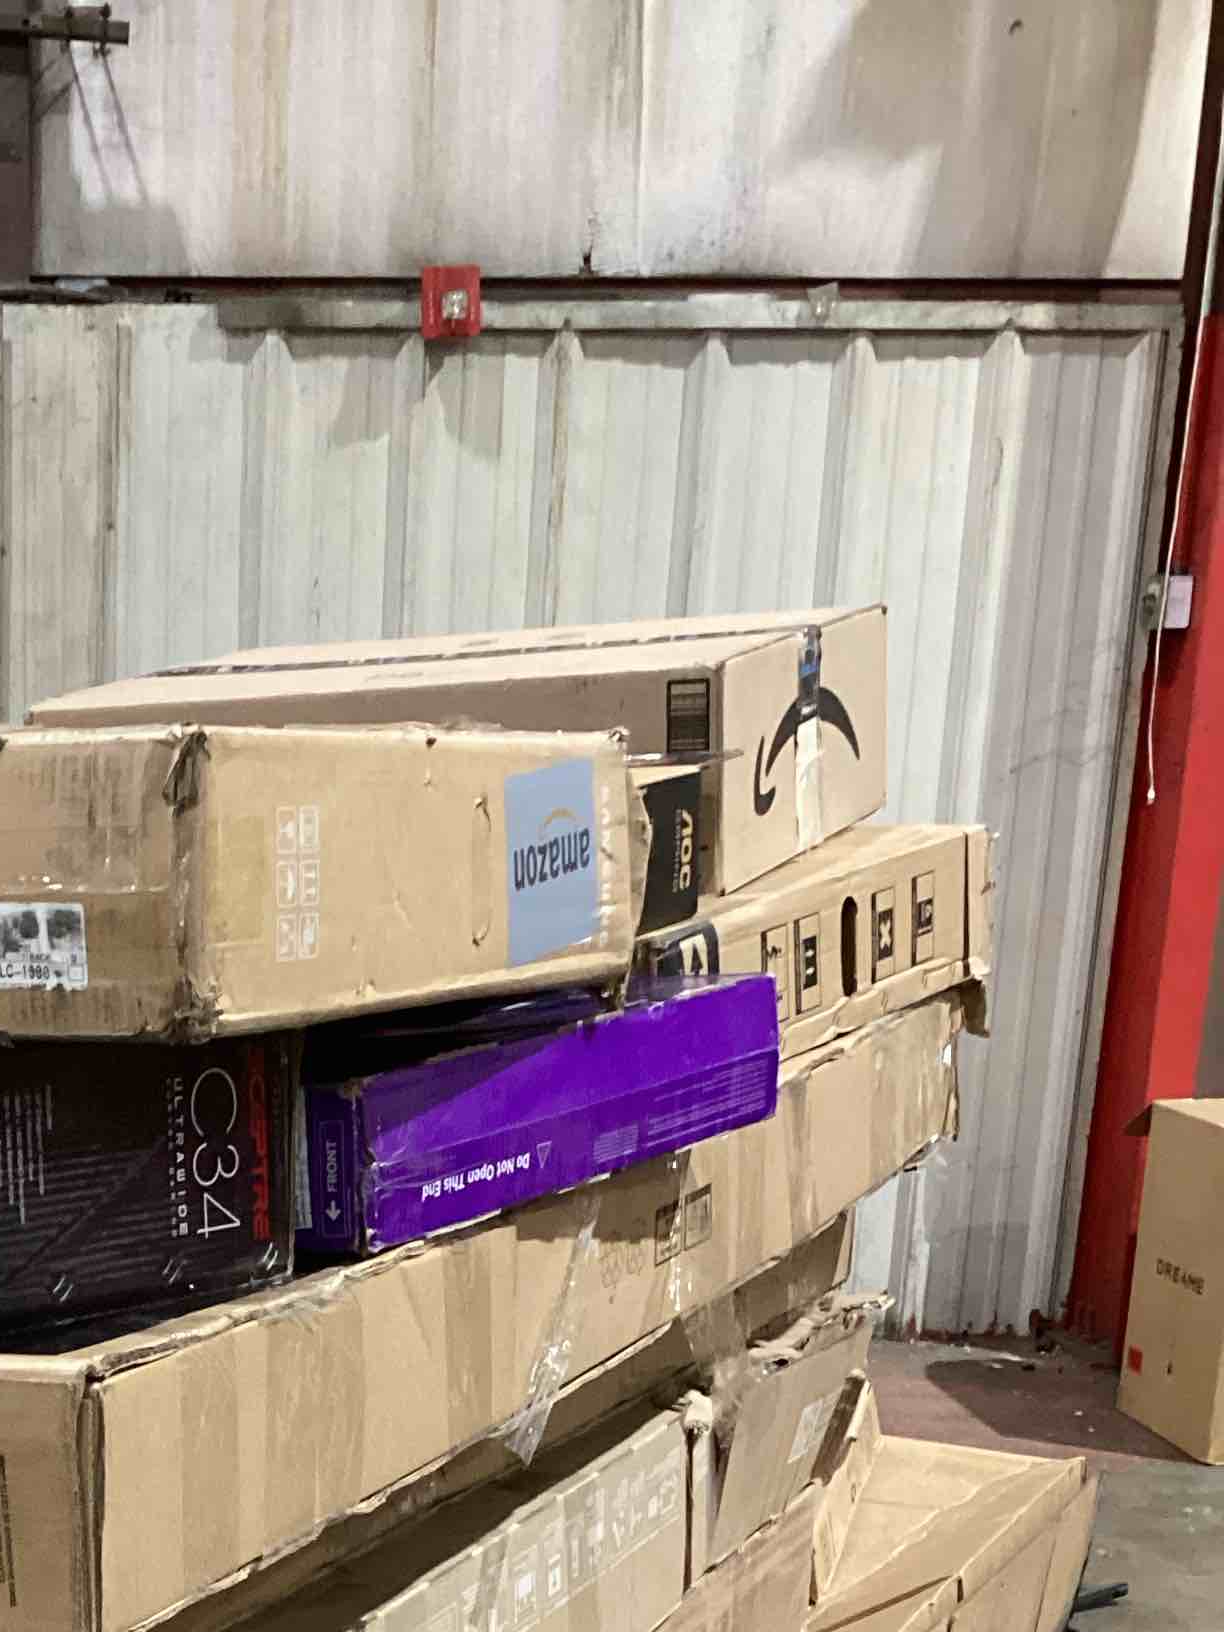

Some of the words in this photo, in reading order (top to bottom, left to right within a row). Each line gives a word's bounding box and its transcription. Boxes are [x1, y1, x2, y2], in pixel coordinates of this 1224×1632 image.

[514, 828, 592, 892] amazon
[679, 808, 694, 891] AOC
[174, 1077, 189, 1237] ULTRAWIDE
[190, 1068, 241, 1240] C34
[325, 1140, 338, 1193] FRONT
[467, 1163, 495, 1182] Open
[496, 1157, 515, 1178] Not
[516, 1152, 531, 1169] Do
[421, 1180, 441, 1203] End
[443, 1173, 465, 1194] This
